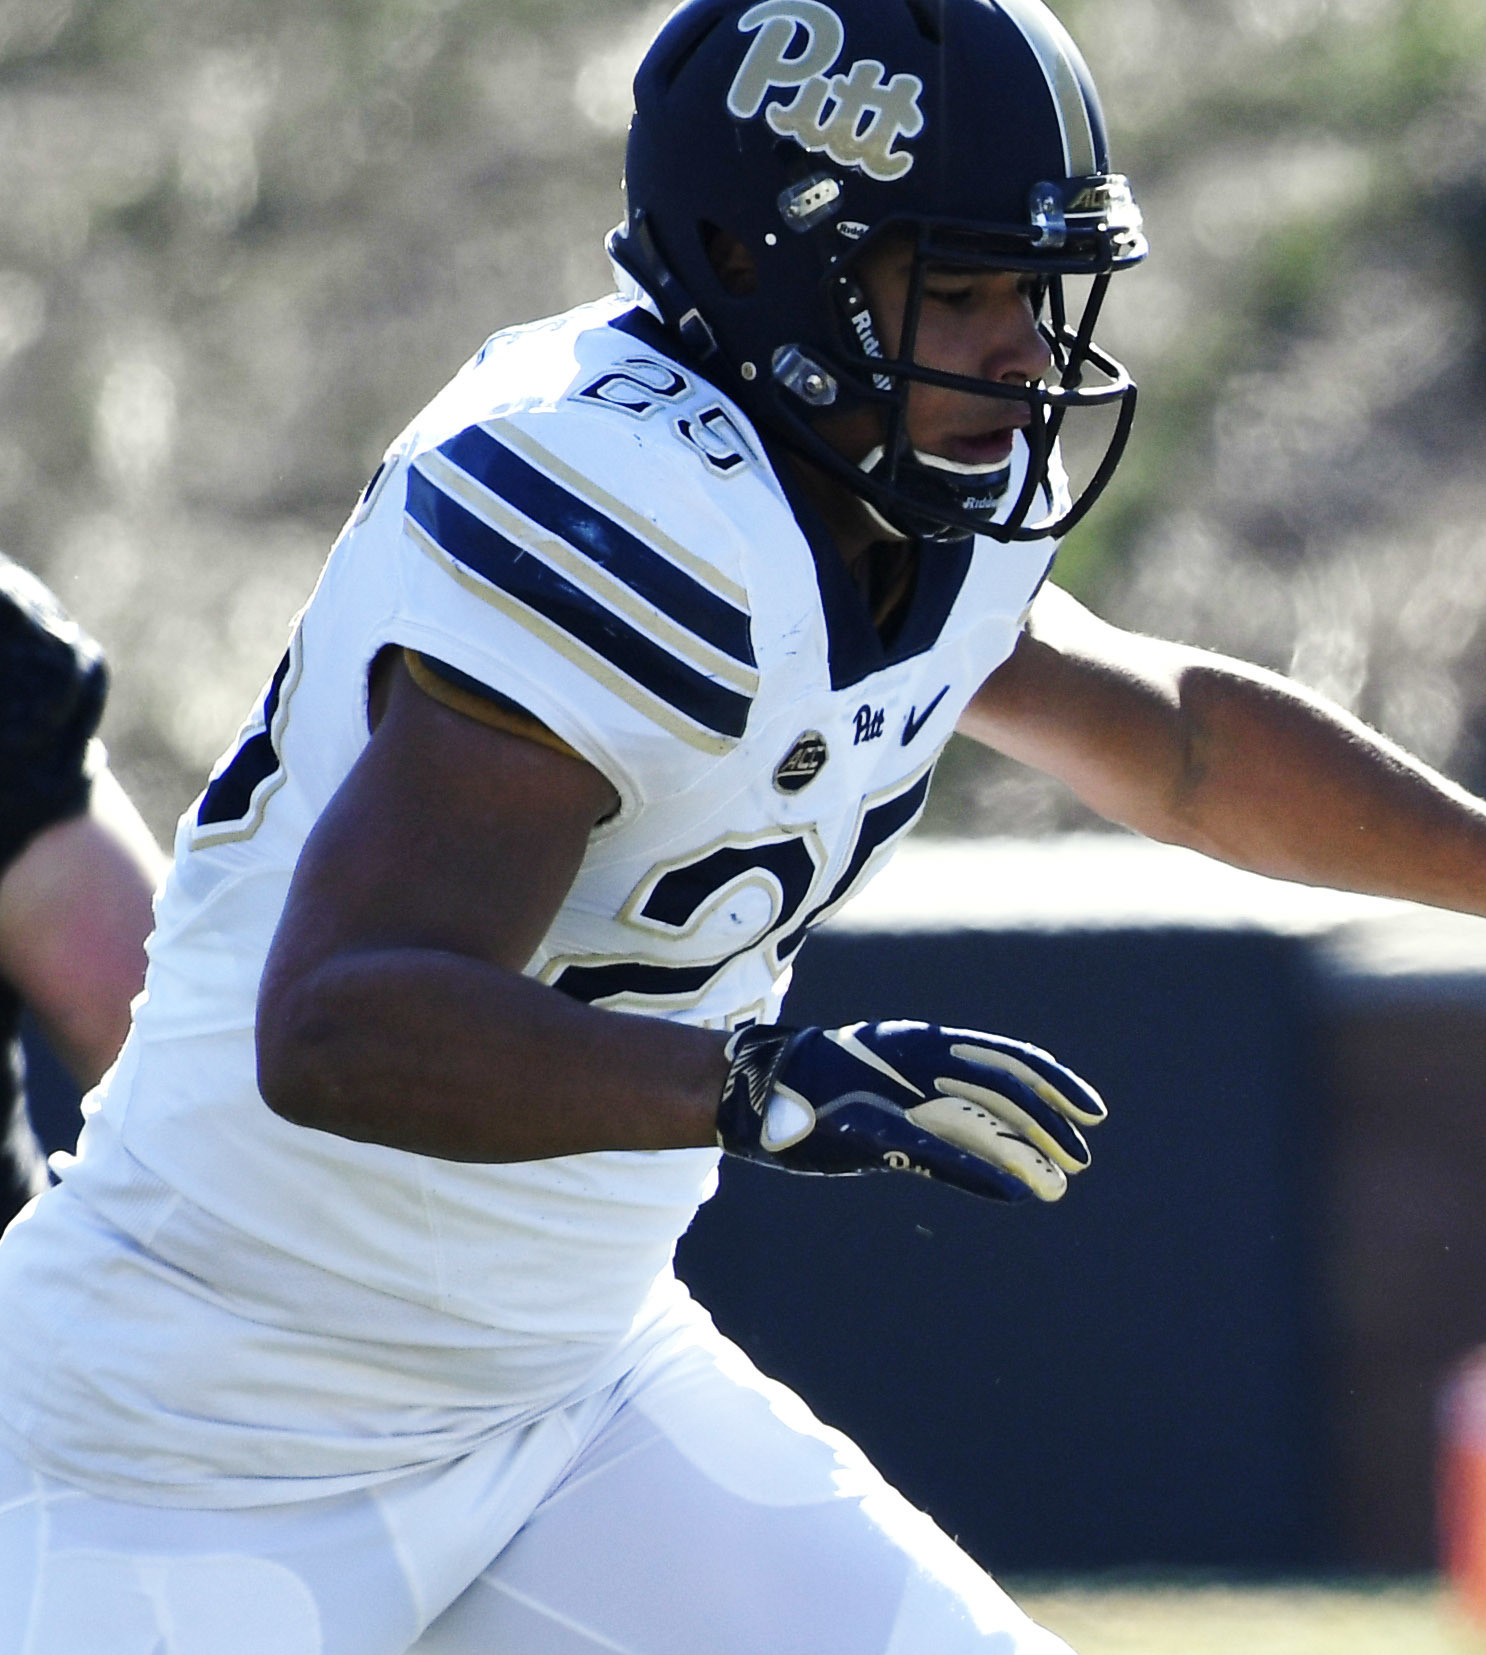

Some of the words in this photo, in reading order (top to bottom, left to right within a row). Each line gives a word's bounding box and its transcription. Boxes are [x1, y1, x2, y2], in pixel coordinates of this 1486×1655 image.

[726, 1, 925, 181] Pitt
[568, 355, 768, 481] 25
[852, 703, 886, 746] Pitt
